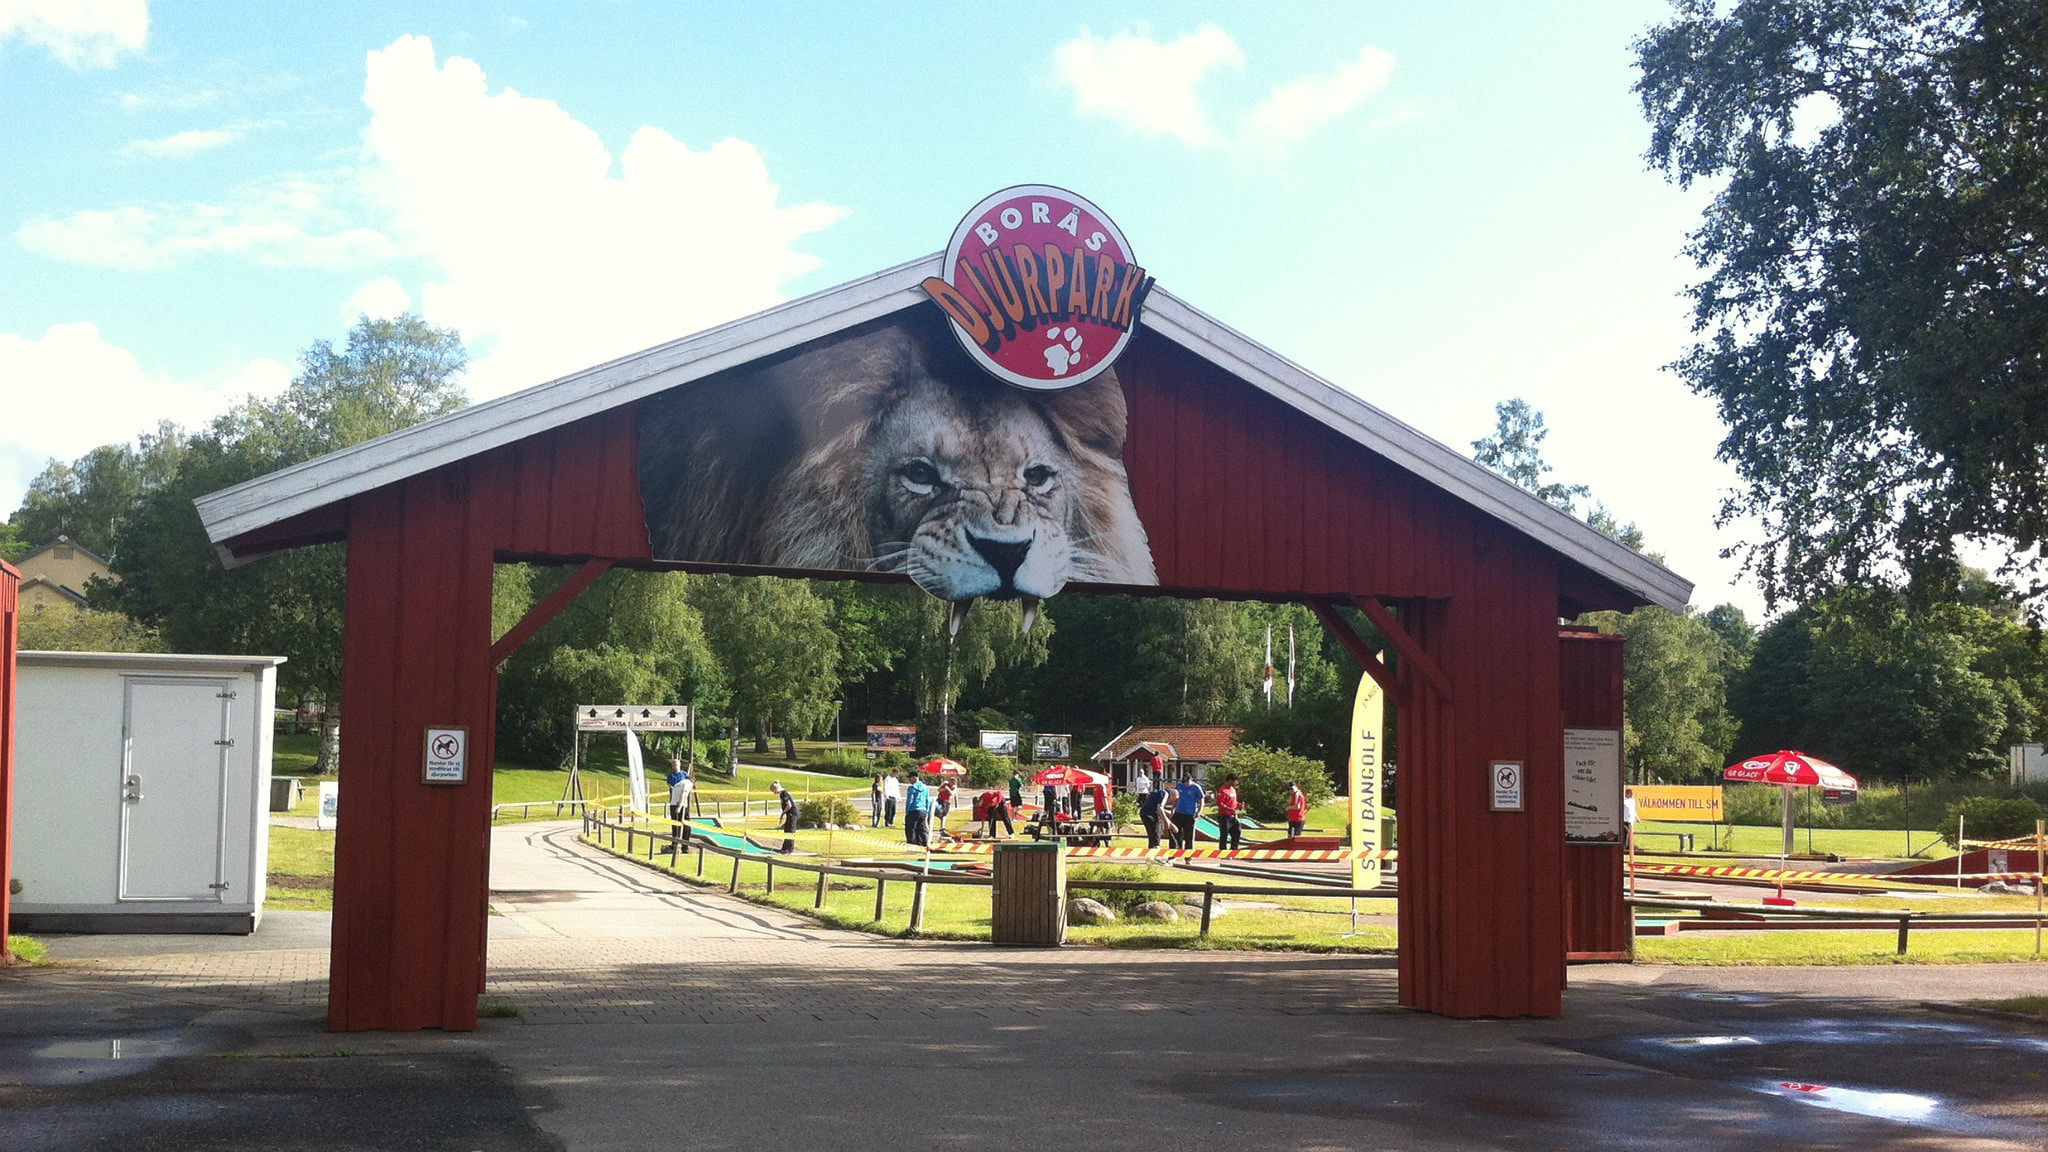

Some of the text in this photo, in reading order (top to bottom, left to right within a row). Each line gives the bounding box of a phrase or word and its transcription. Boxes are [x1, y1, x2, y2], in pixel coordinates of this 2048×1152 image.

[974, 201, 1108, 252] BORÅS
[920, 243, 1148, 347] DJURPARK
[1361, 729, 1376, 821] BANGOLF
[1638, 797, 1719, 809] VÄLKOMMEN TILL SM
